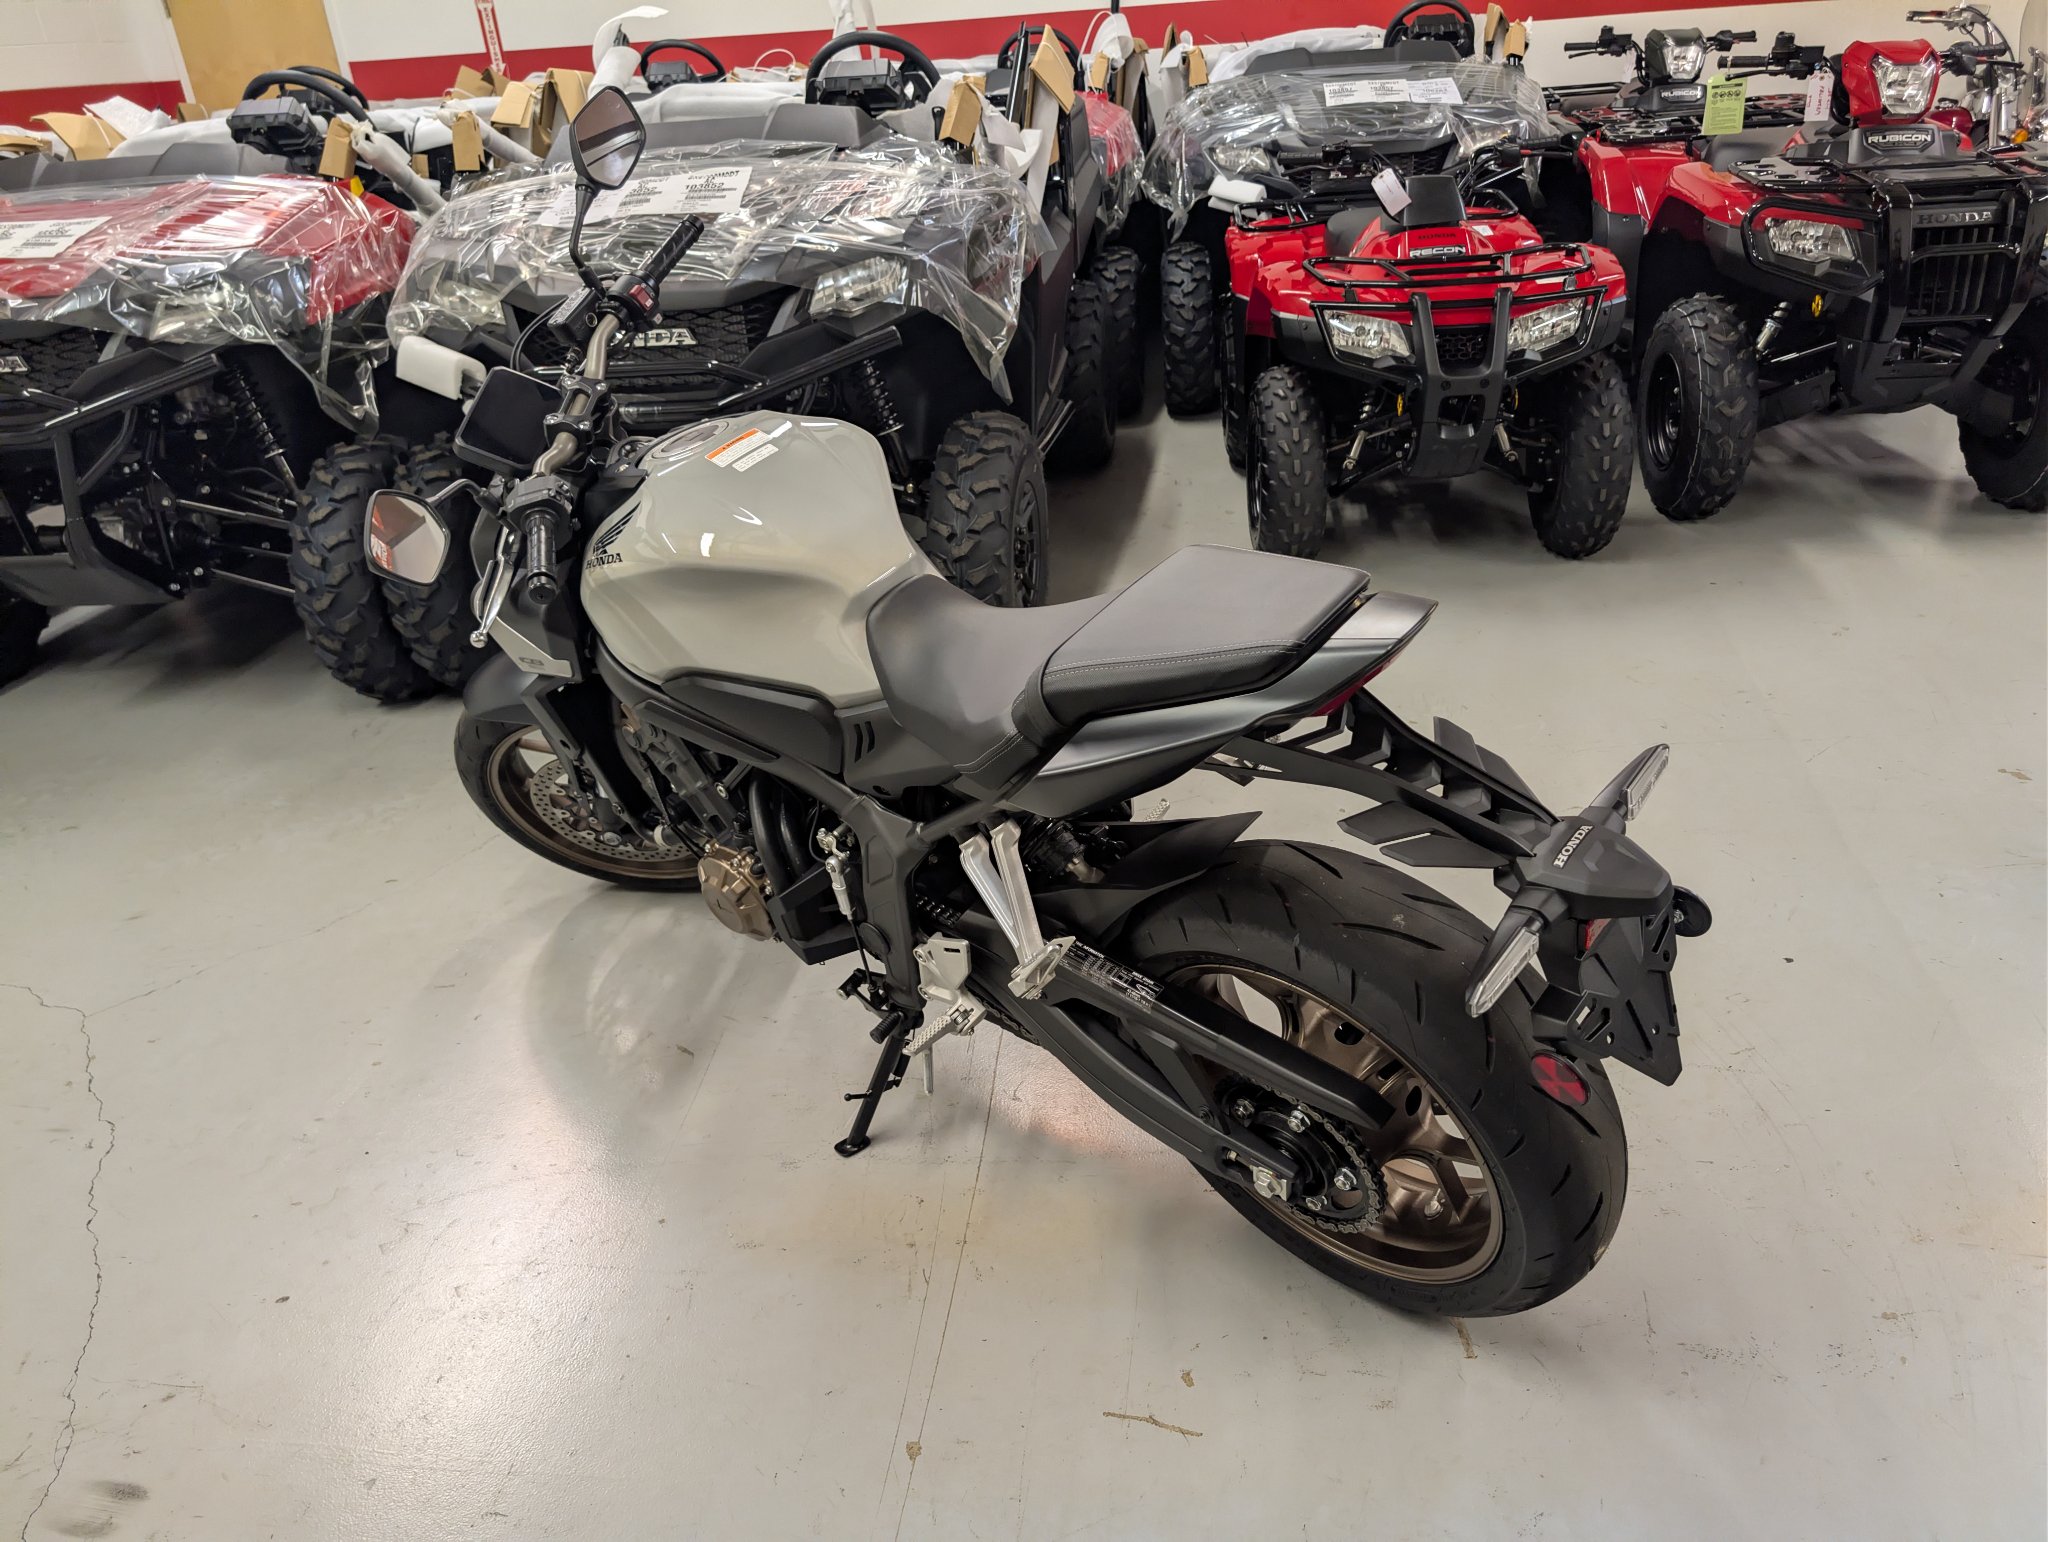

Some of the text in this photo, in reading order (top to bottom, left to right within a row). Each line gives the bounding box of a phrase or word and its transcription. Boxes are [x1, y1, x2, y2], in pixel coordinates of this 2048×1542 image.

[1661, 88, 1702, 98] RUBICON
[1868, 134, 1931, 144] RUBICON
[1916, 211, 1993, 225] HONDA
[1409, 246, 1467, 258] RECON
[585, 552, 623, 569] HONDA
[1553, 825, 1594, 868] HONDA
